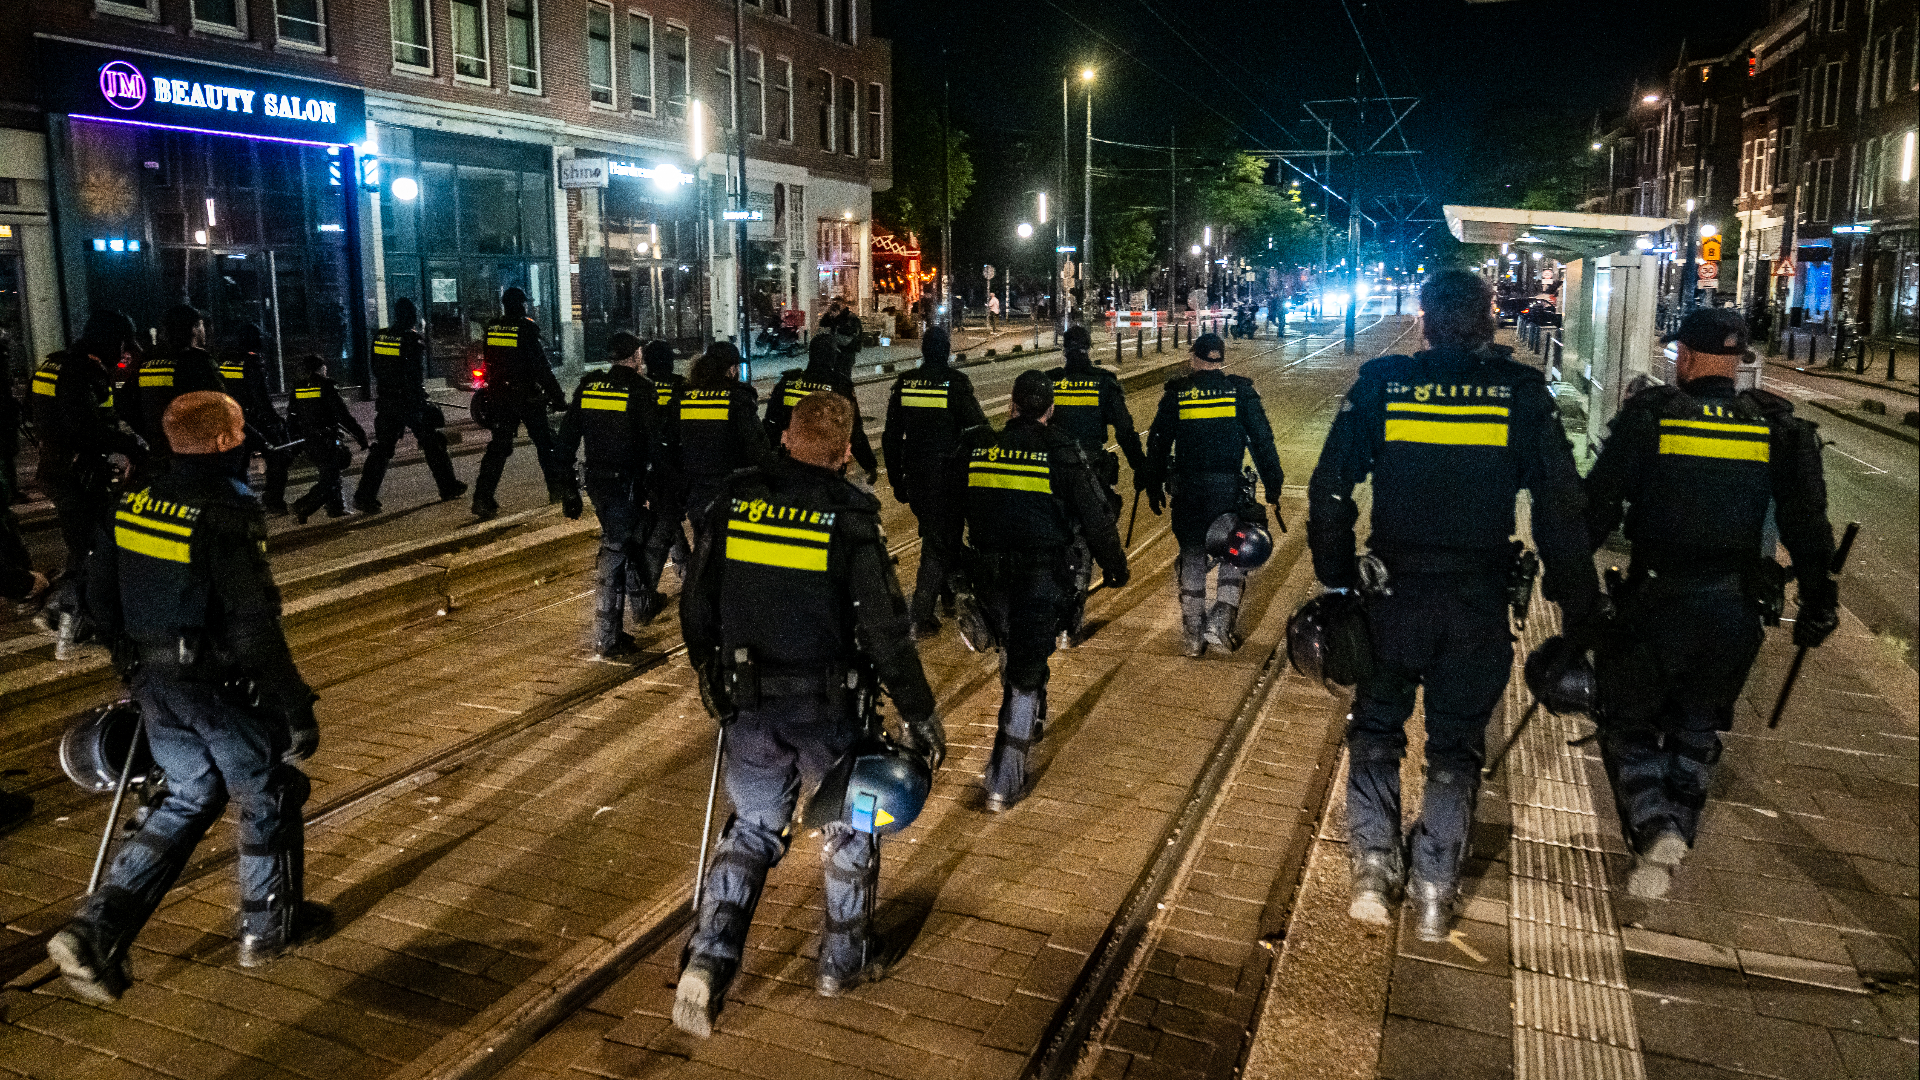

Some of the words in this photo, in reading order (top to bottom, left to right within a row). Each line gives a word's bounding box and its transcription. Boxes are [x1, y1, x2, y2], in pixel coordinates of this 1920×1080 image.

[105, 70, 142, 100] JM
[153, 76, 255, 113] BEAUTY
[264, 92, 337, 123] SALON
[1055, 377, 1094, 390] POLITIE
[1400, 383, 1499, 402] POLITIE
[981, 445, 1038, 461] POLITIE
[127, 488, 190, 519] POLITIE
[739, 499, 822, 524] POLITIE
